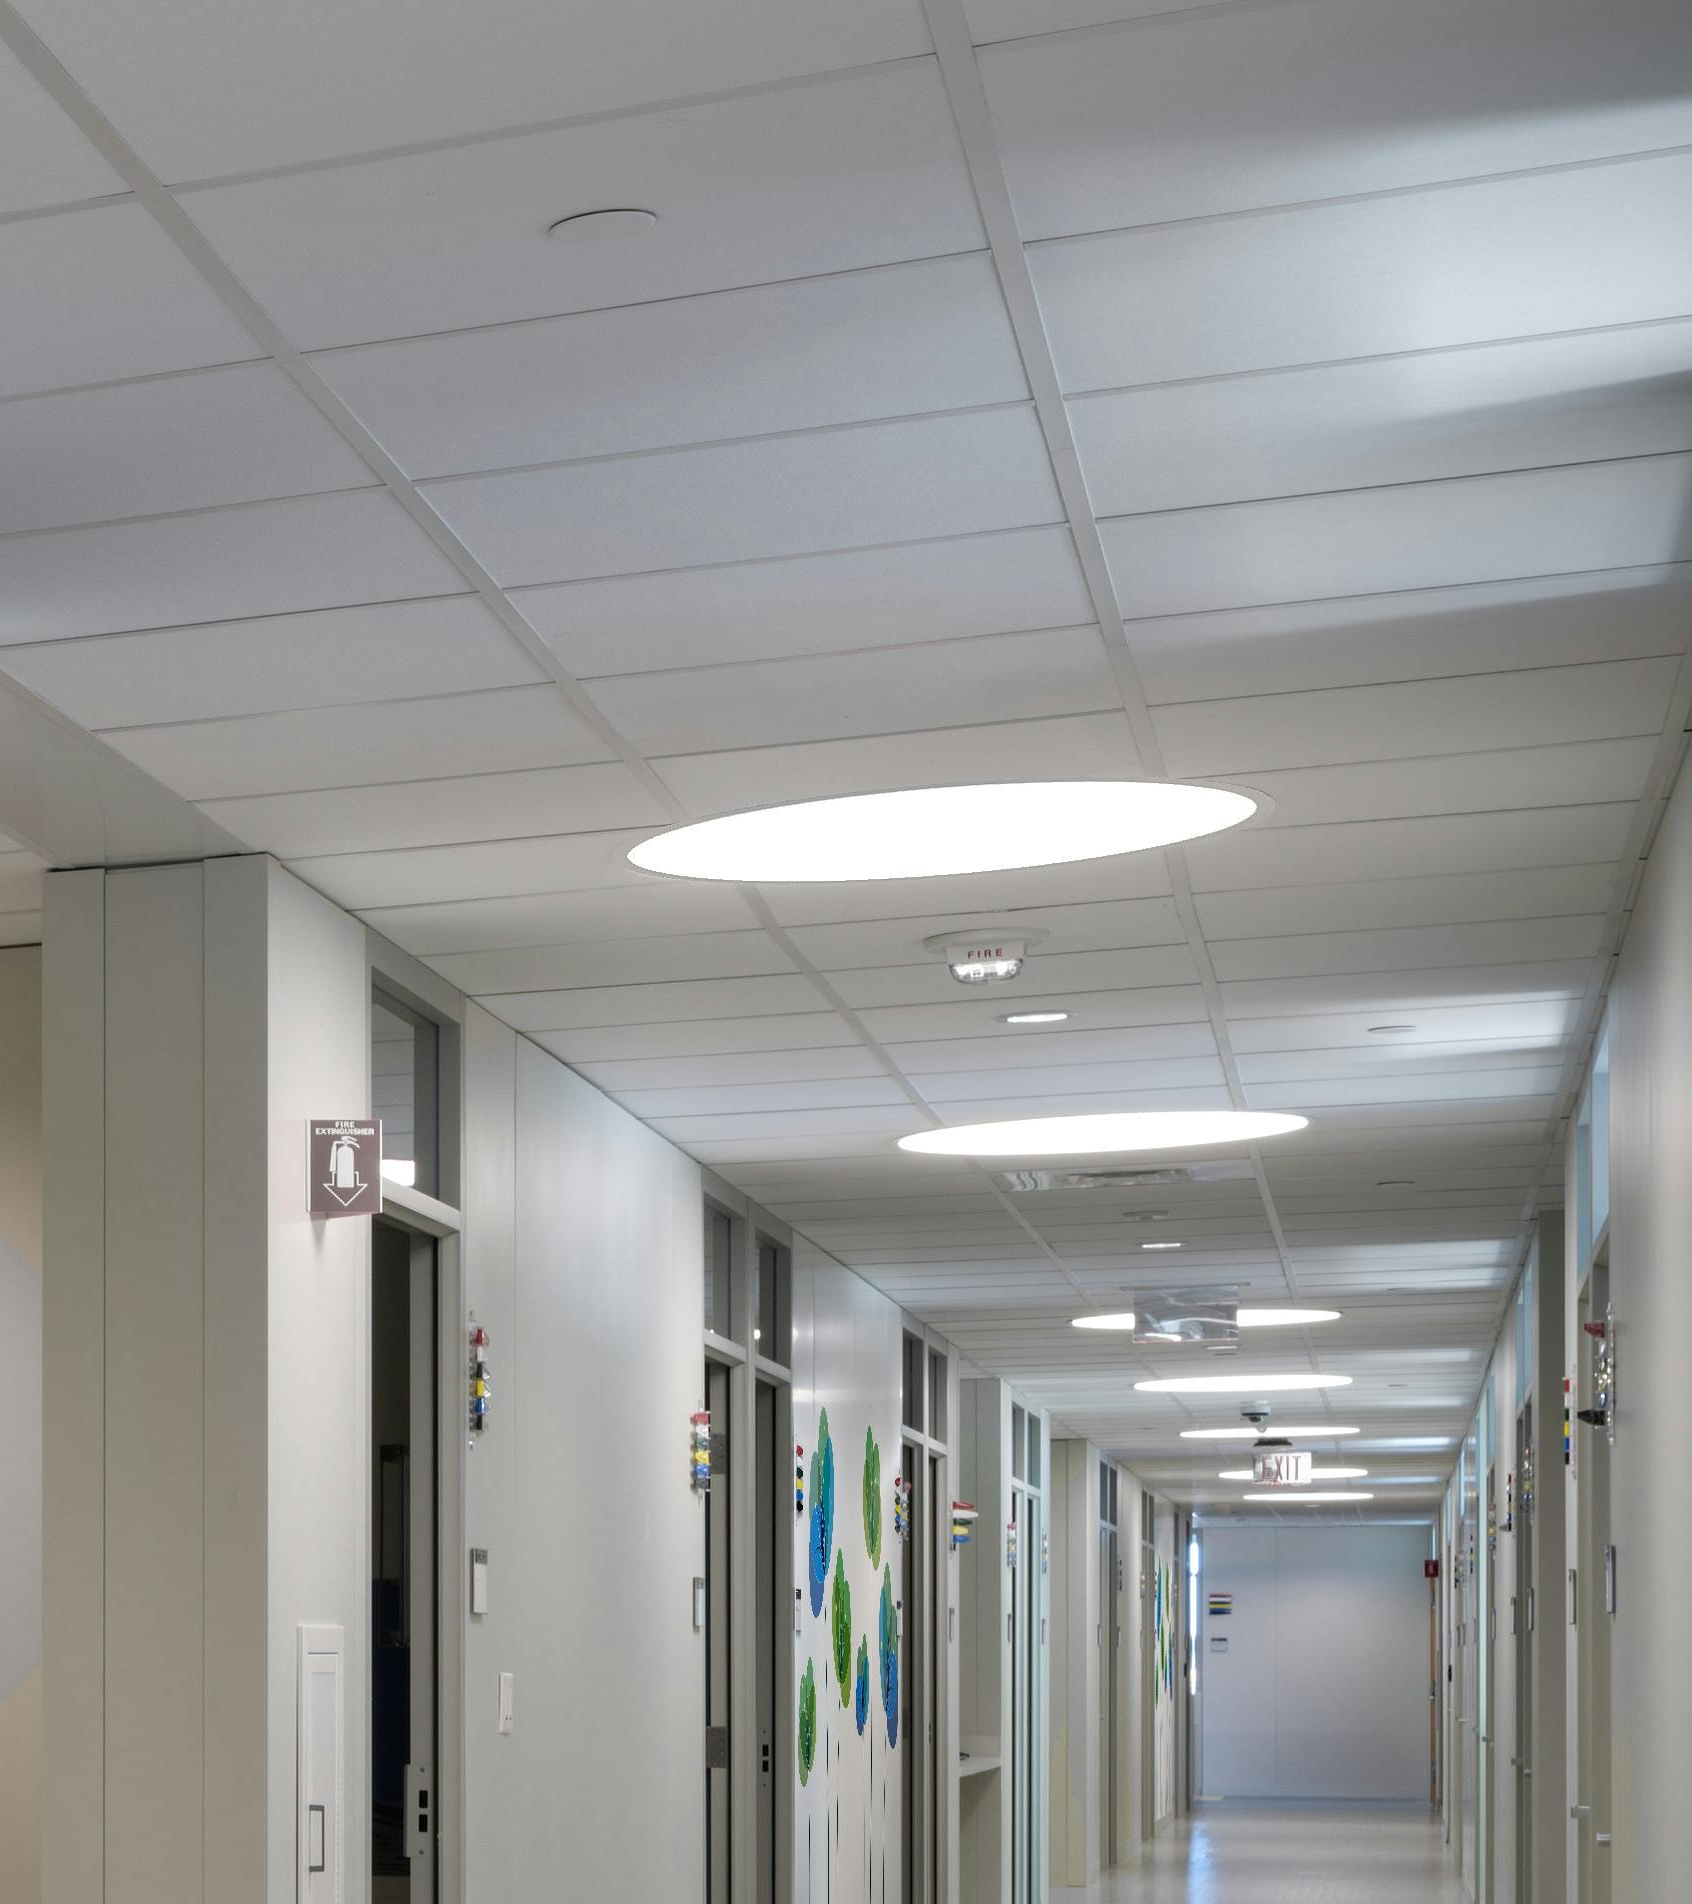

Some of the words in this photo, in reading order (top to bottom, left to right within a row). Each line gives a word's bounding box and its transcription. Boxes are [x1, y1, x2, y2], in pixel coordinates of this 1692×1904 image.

[967, 948, 1003, 959] FIRE
[335, 1120, 355, 1128] FIRE
[315, 1127, 375, 1136] EXTINGUISHER
[1261, 1455, 1302, 1482] EXIT
